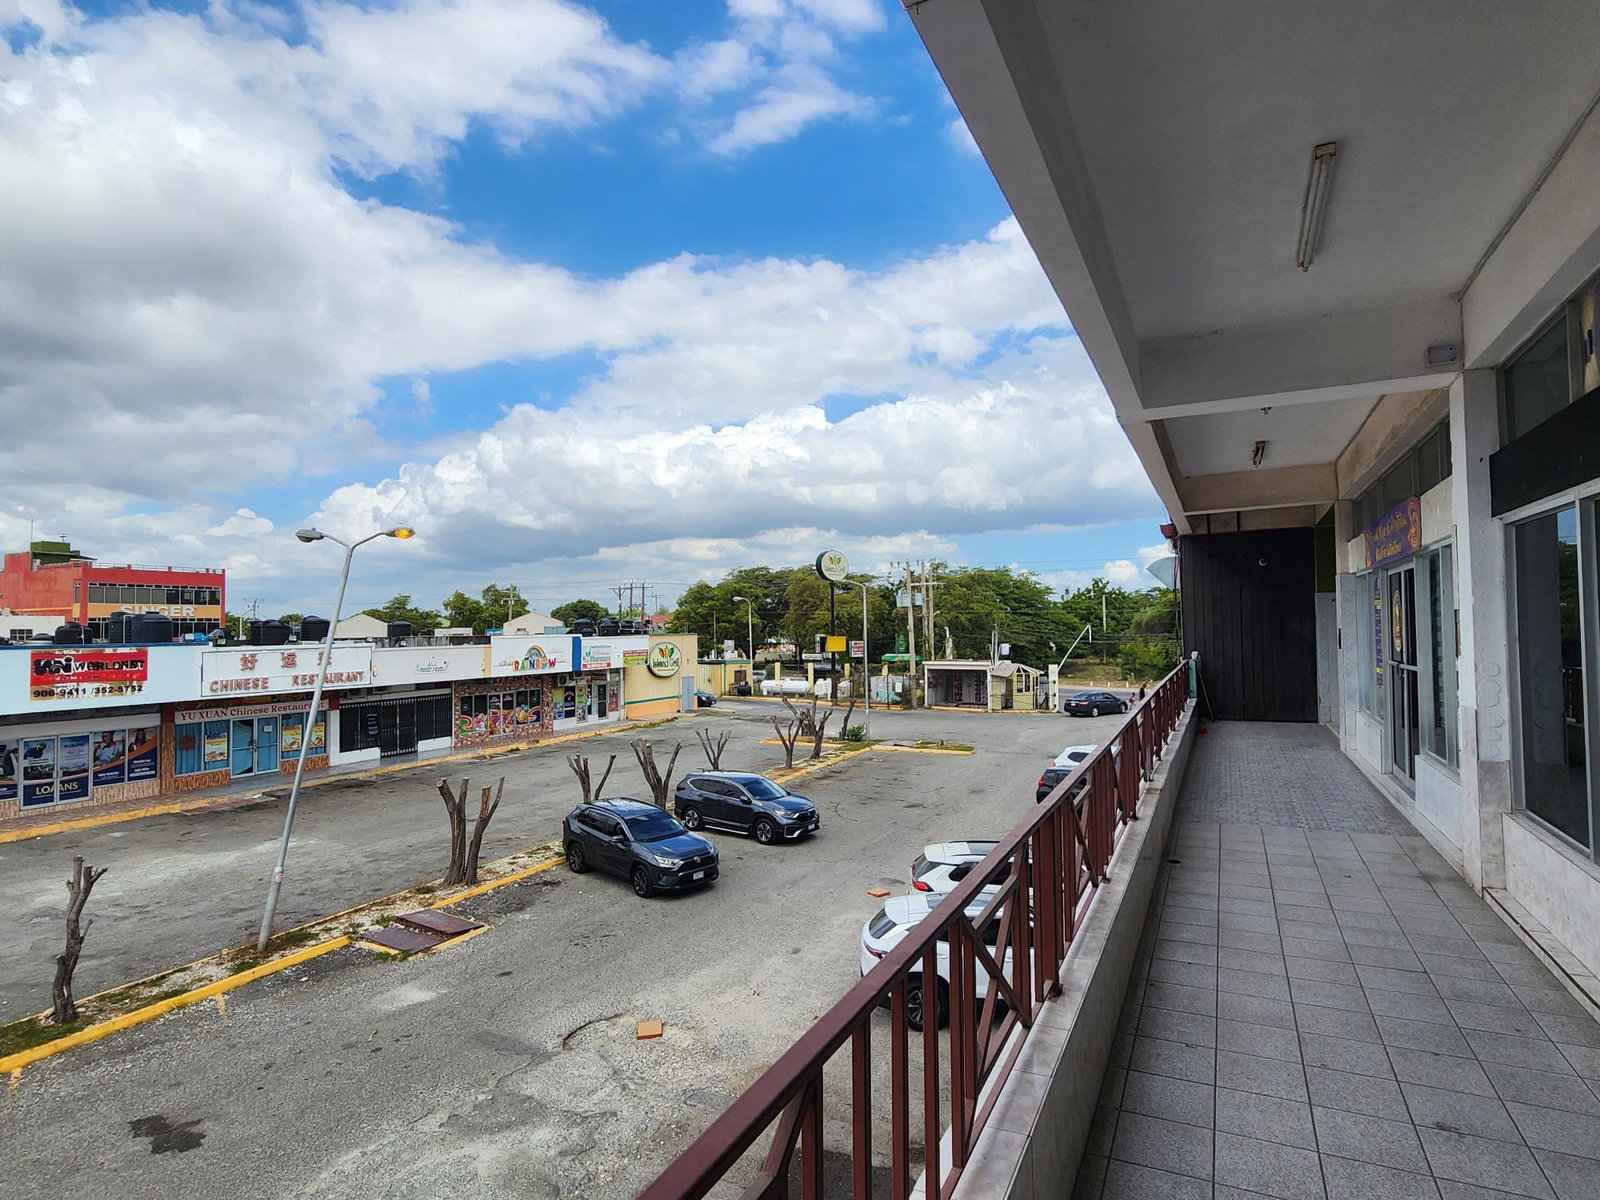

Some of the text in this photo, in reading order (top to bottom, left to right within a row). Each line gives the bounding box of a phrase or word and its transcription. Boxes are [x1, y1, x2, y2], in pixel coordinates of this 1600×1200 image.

[209, 671, 365, 693] CHINESE RESAURANT
[180, 701, 325, 721] YU XUAN Chinese Restaurt
